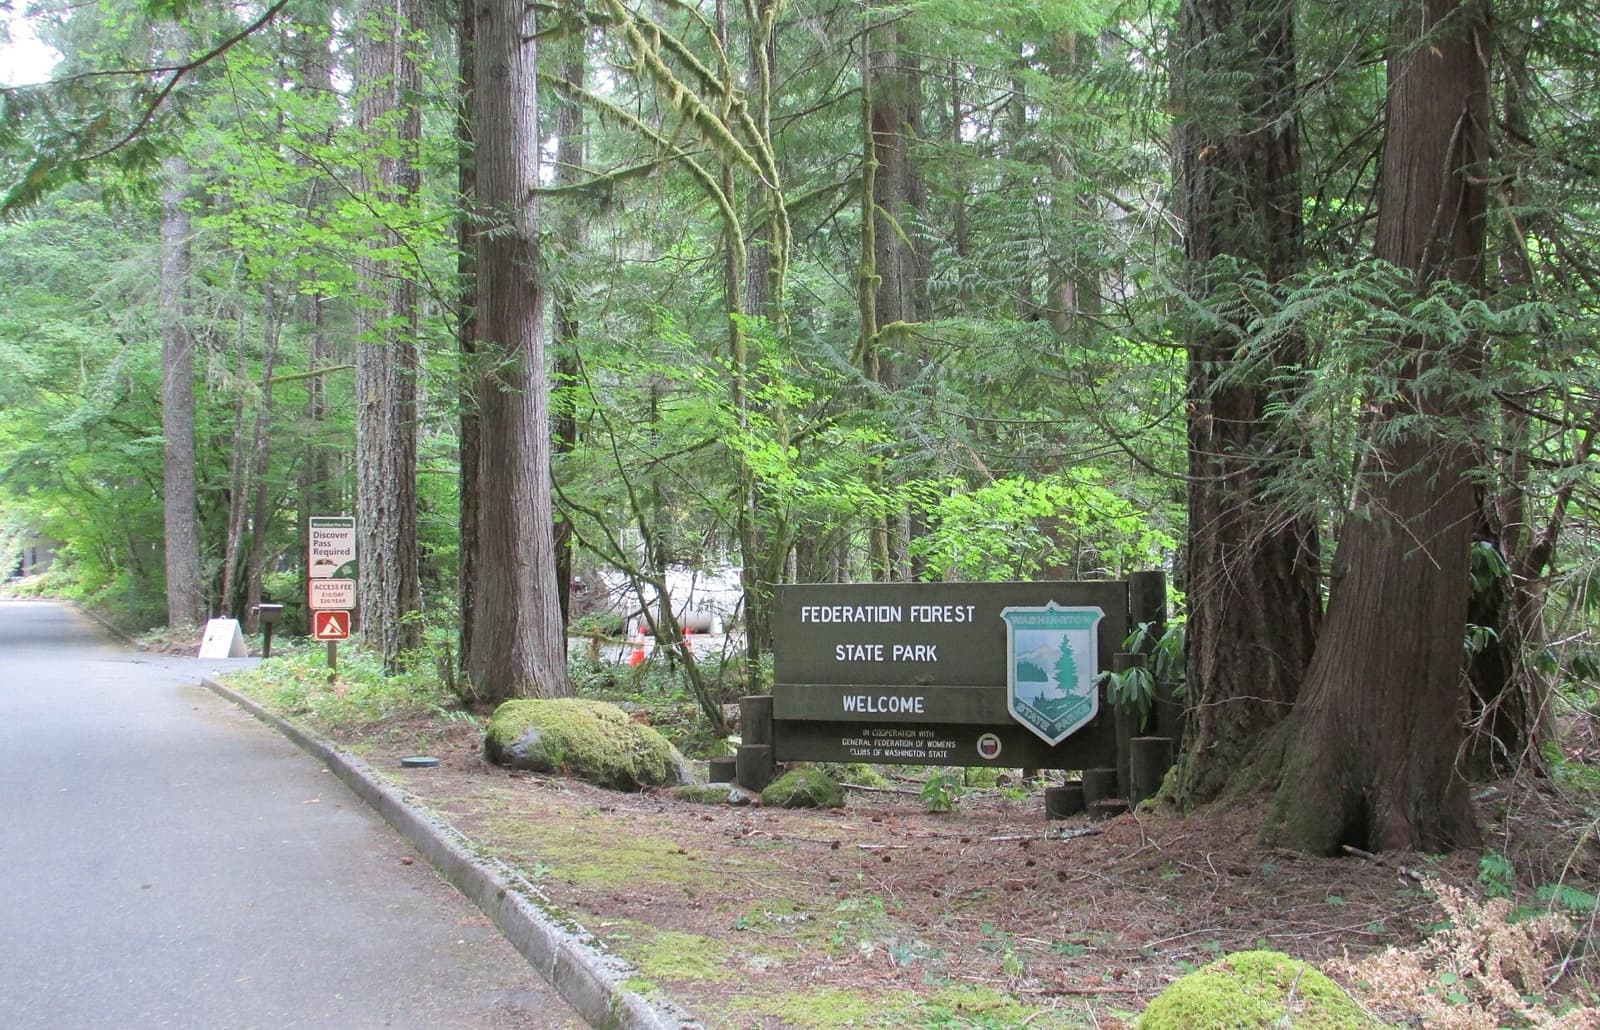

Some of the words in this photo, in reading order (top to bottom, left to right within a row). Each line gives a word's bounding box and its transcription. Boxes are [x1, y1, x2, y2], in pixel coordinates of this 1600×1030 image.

[313, 531, 348, 539] Discover
[313, 547, 350, 557] Required
[801, 605, 902, 623] FEDERATION
[910, 605, 976, 623] FOREST
[1010, 615, 1092, 625] WASHINGTON
[835, 644, 884, 662] STATE
[892, 644, 938, 662] PARK
[842, 695, 925, 714] WELCOME
[1016, 703, 1050, 732] STATE
[1054, 703, 1090, 732] PARKS
[862, 729, 870, 737] IN
[872, 729, 916, 738] COOPERATION
[918, 730, 935, 738] WITH
[841, 738, 871, 746] GENERAL
[874, 738, 913, 747] FEDERATION
[916, 739, 924, 747] OF
[873, 748, 882, 756] OF
[884, 749, 926, 758] WASHINGTON
[928, 750, 948, 758] STATE
